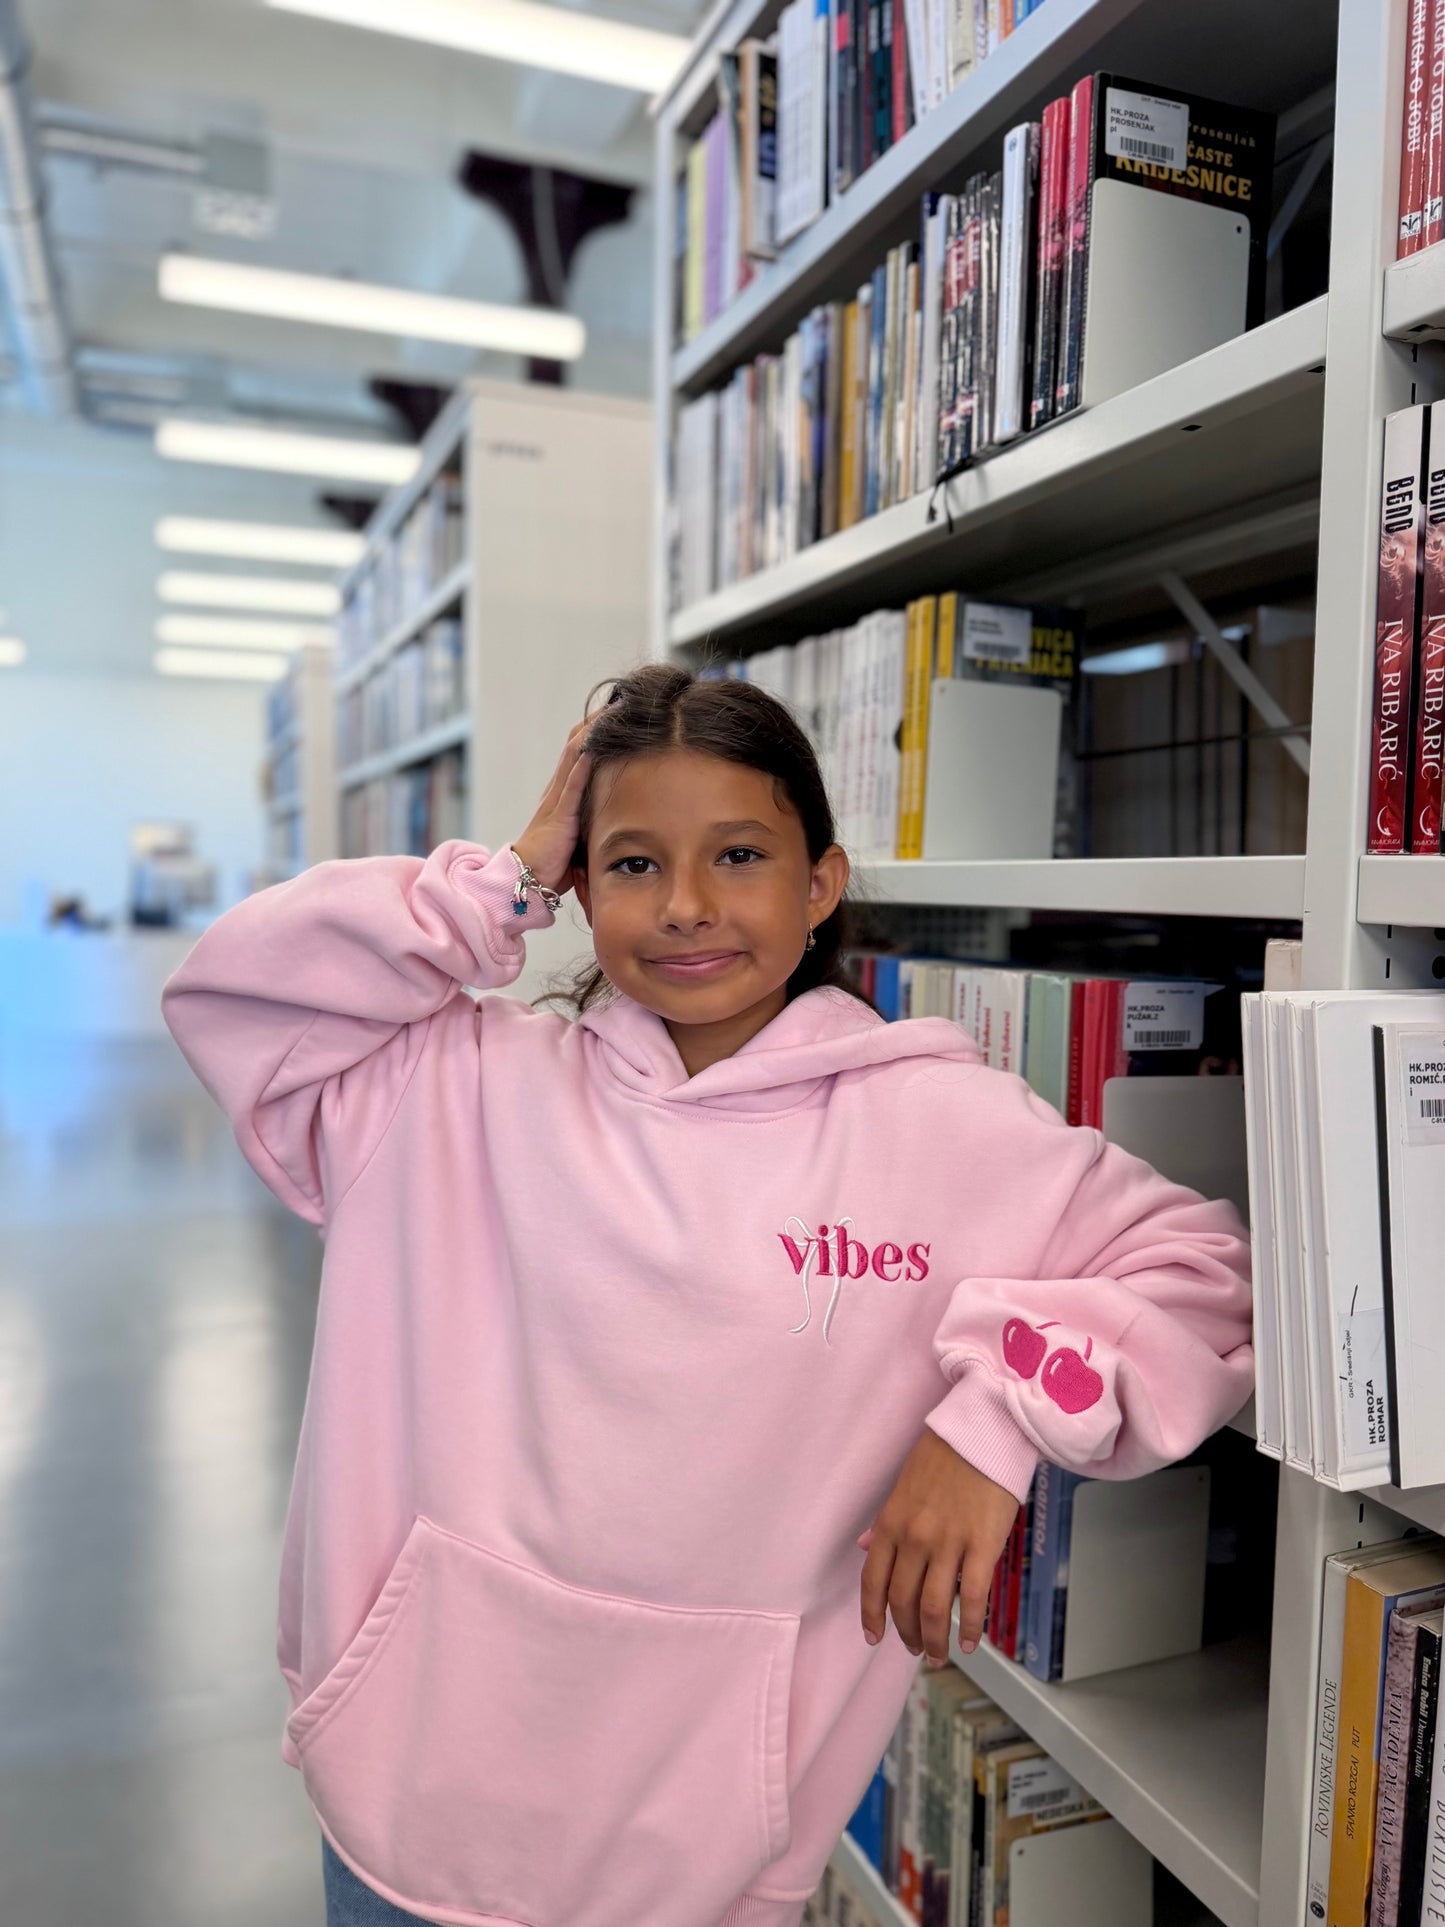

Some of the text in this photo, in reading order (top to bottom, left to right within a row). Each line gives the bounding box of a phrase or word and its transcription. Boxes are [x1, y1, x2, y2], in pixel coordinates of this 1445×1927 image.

[1110, 107, 1150, 122] HK.PROZA
[1110, 116, 1156, 133] PROSENJAK
[1378, 617, 1404, 782] IVA RIBARIĆ
[777, 1224, 931, 1282] vibes
[1366, 1379, 1377, 1445] HK.PROZA
[1377, 1396, 1386, 1443] ROMAR
[1315, 1678, 1337, 1839] ROVINJSKE LEGENDE
[1346, 1796, 1357, 1840] STANKO
[1352, 1725, 1362, 1749] PUT
